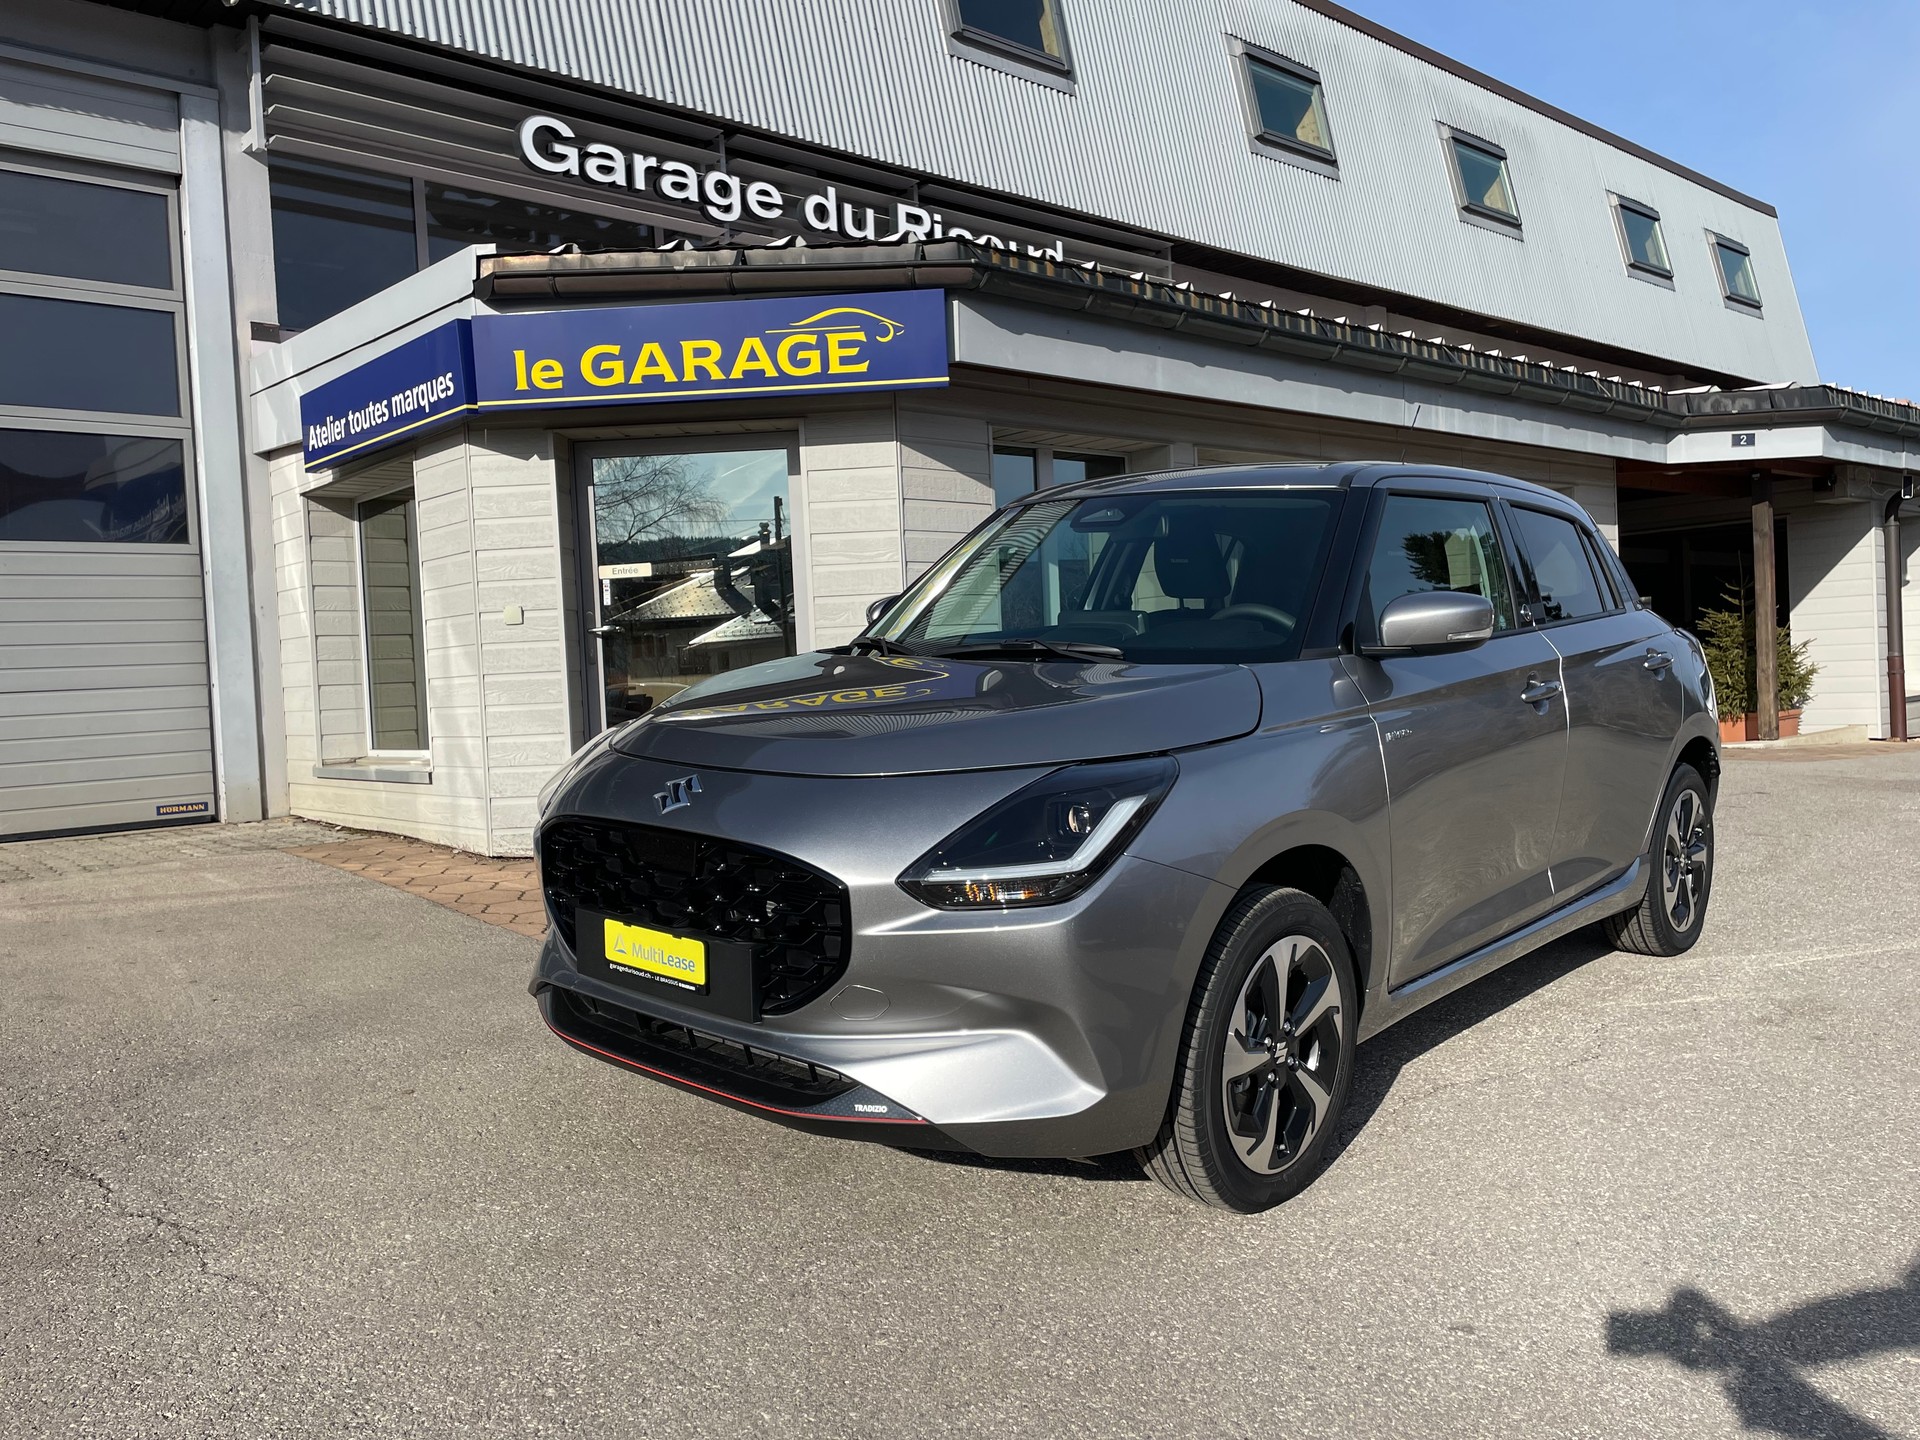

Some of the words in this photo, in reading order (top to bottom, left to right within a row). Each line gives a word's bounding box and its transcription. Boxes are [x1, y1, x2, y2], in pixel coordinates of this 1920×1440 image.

[518, 115, 783, 222] Garage
[804, 186, 874, 240] du
[513, 350, 564, 391] le
[580, 331, 870, 387] GARAGE
[308, 415, 346, 451] Atelier
[348, 399, 389, 435] toutes
[391, 372, 455, 417] marques
[1740, 435, 1747, 445] 2
[612, 566, 639, 575] Entrée
[631, 942, 696, 973] MultiLease
[854, 1104, 888, 1113] TRADIZIO
